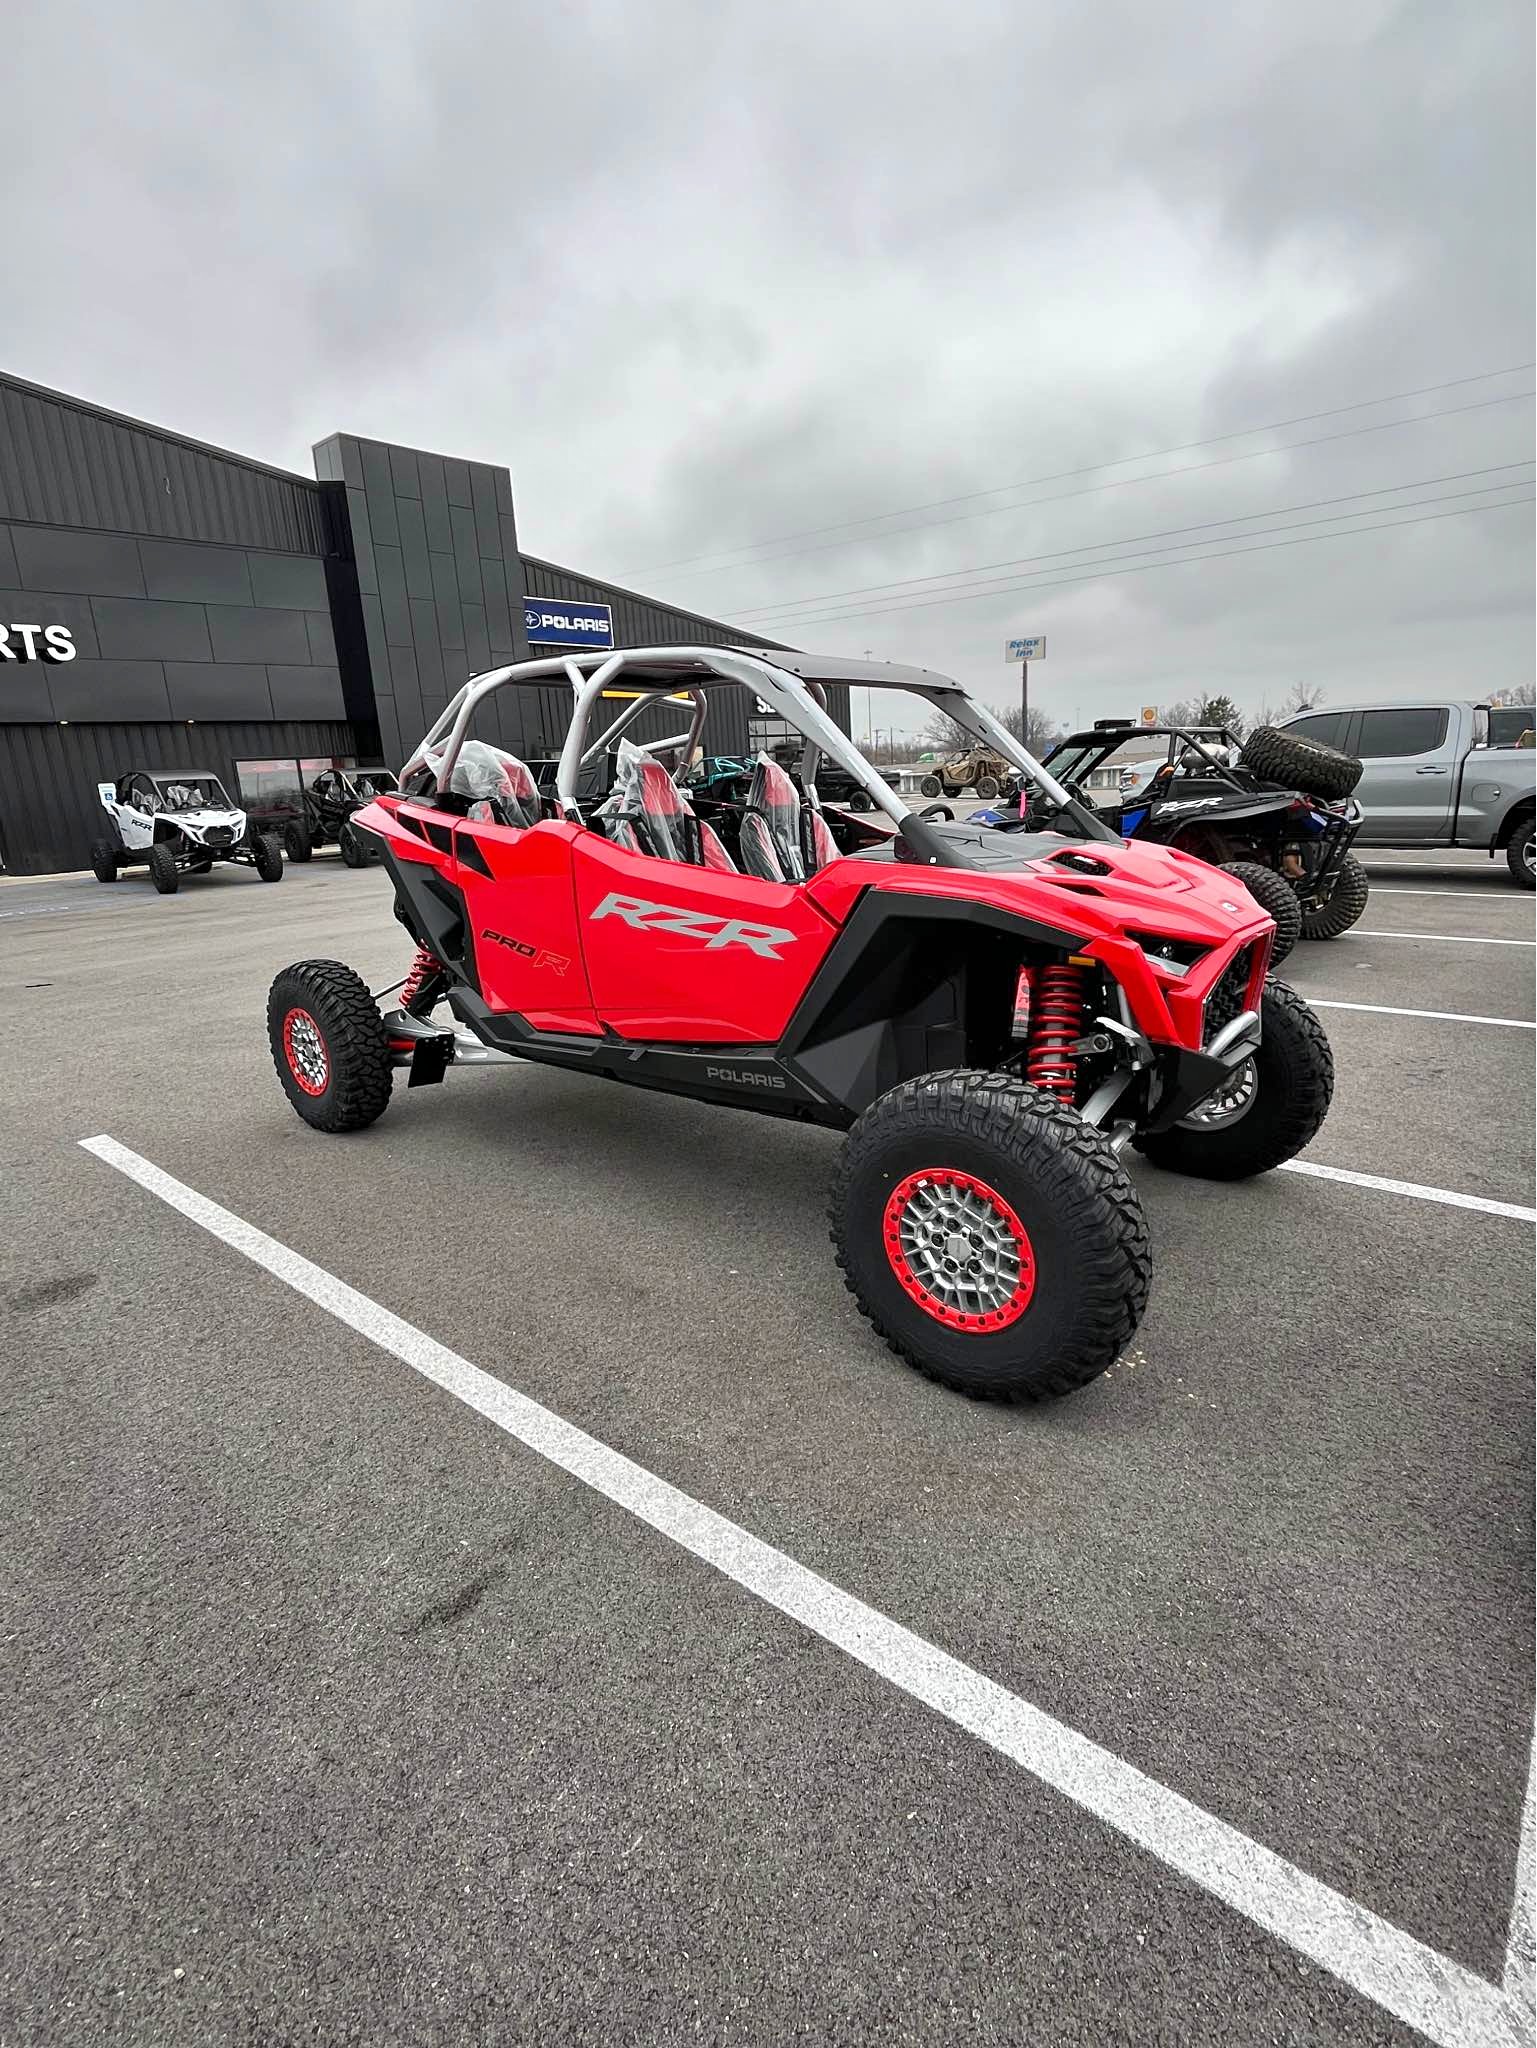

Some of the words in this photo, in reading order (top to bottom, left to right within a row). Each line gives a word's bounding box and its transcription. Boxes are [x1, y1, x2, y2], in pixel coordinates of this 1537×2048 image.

[541, 614, 610, 632] POLARIS
[1009, 638, 1039, 649] Relax
[1015, 649, 1033, 658] Inn
[1156, 797, 1223, 815] RZR
[131, 819, 153, 831] RZR
[589, 891, 798, 962] RZR
[481, 928, 537, 958] PRO
[533, 950, 571, 977] R
[706, 1066, 786, 1089] POLARIS
